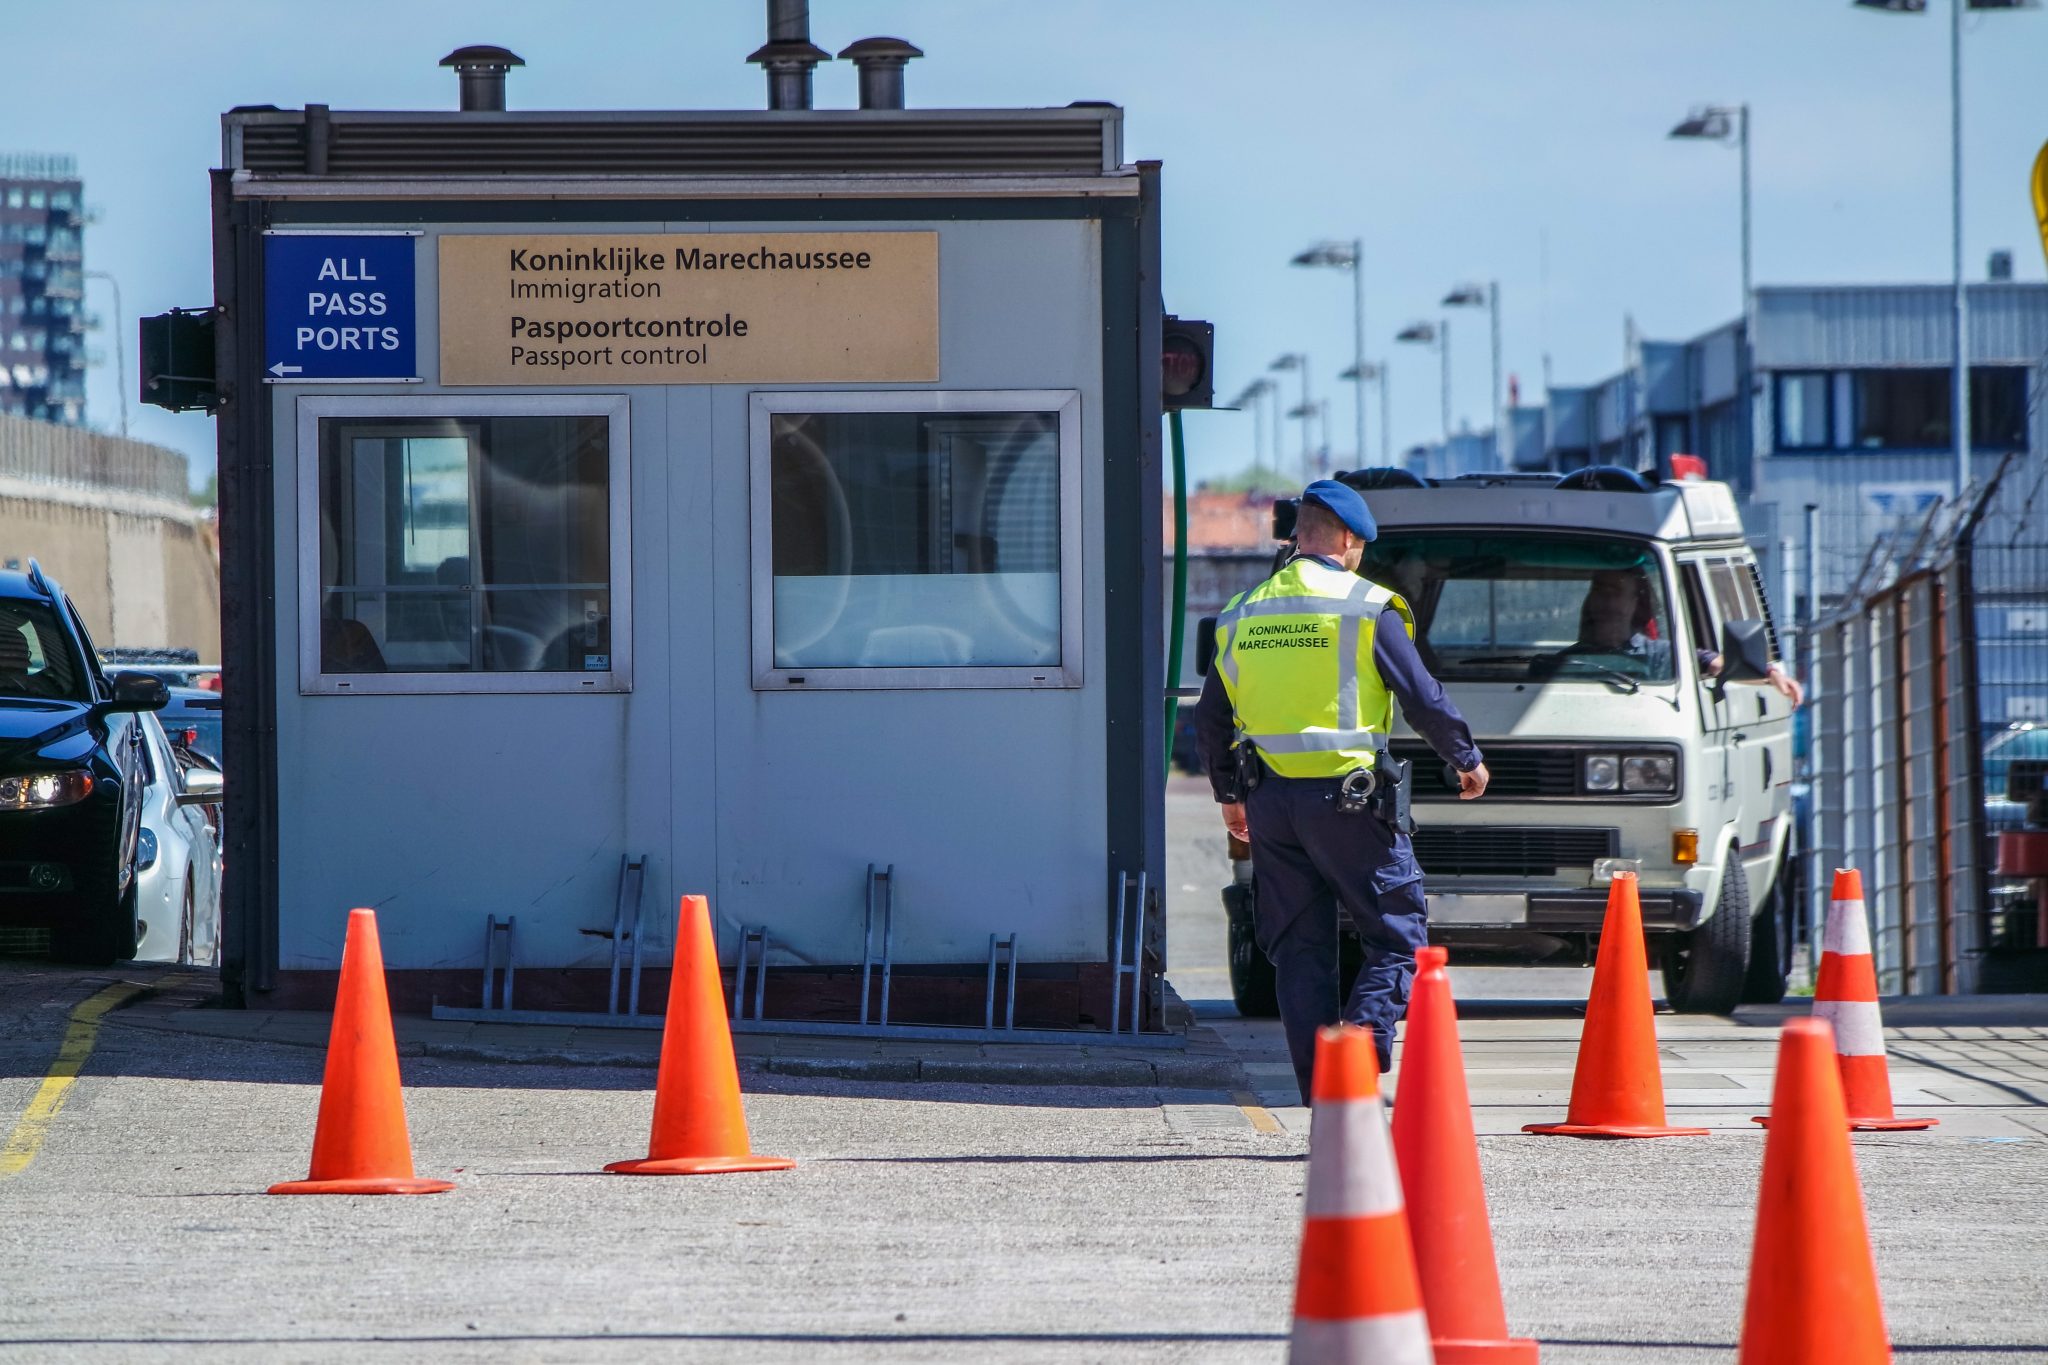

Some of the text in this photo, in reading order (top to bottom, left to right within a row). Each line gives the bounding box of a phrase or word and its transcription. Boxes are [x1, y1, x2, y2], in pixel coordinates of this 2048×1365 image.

[317, 258, 377, 281] ALL
[510, 246, 871, 275] Koninklijke Marechaussee
[510, 277, 661, 304] Immigration
[308, 293, 387, 316] PASS
[297, 327, 399, 350] PORTS
[511, 313, 748, 343] Paspoortcontrole
[511, 343, 707, 370] Passport control
[1248, 623, 1319, 636] KONINKLIJKE
[1238, 637, 1329, 651] MARECHAUSSEE
